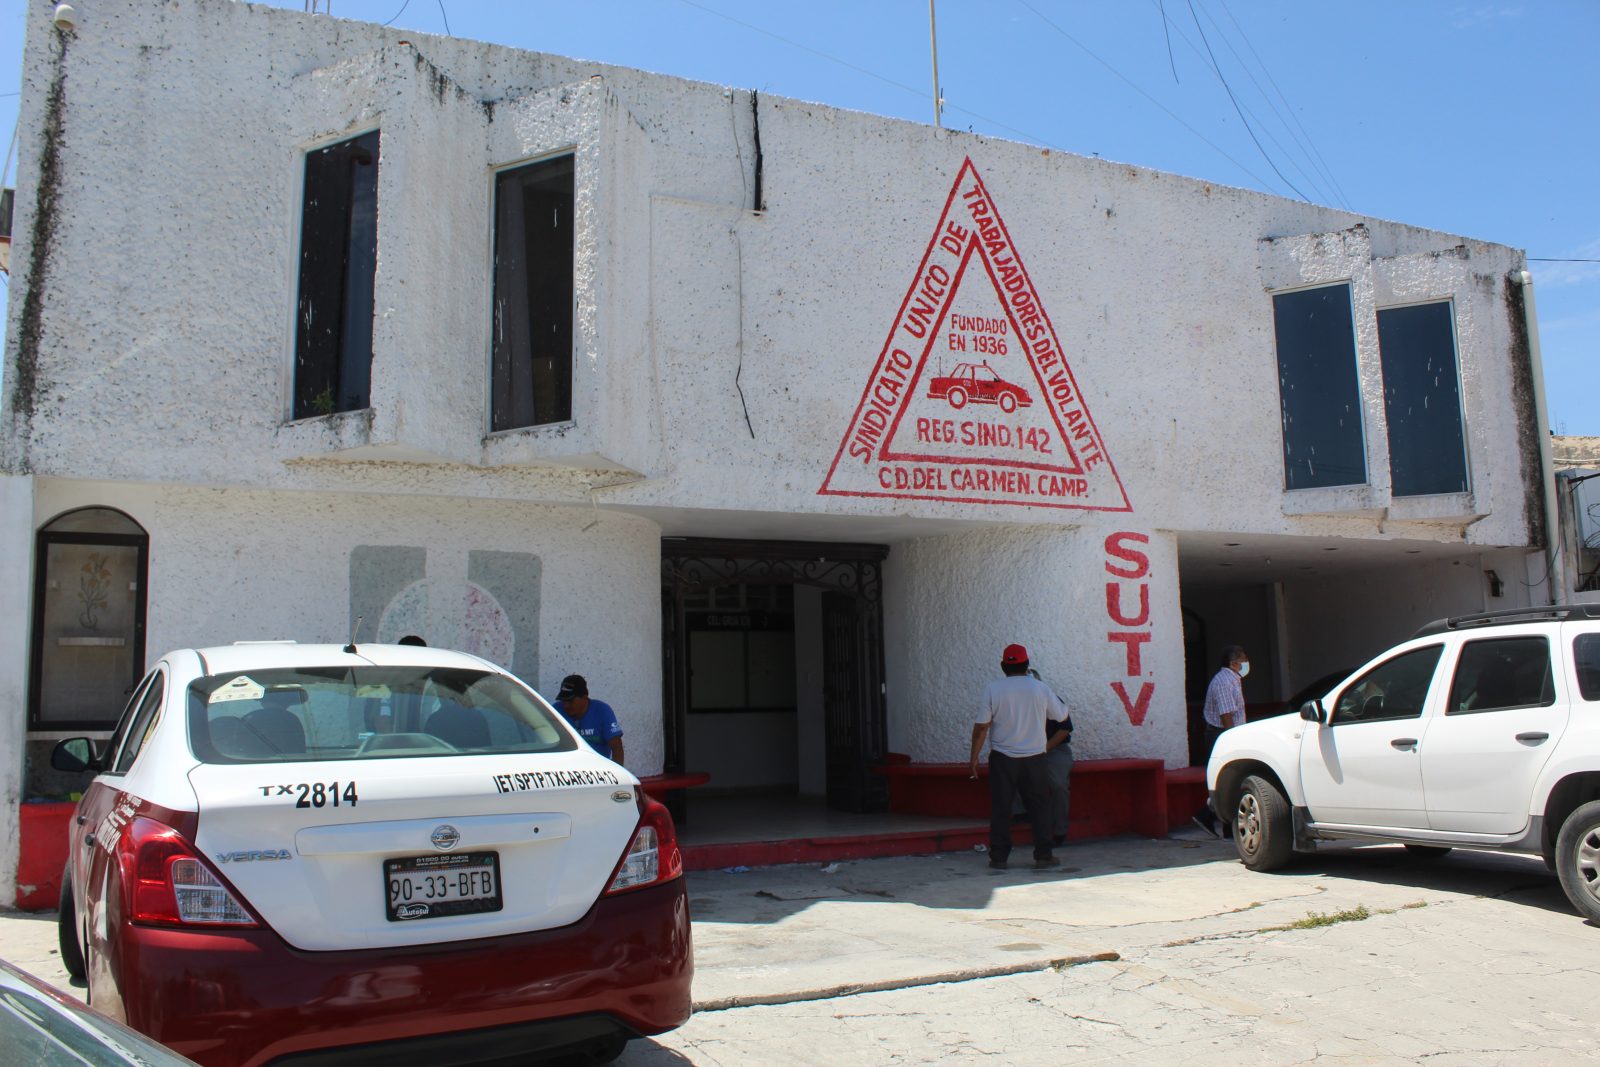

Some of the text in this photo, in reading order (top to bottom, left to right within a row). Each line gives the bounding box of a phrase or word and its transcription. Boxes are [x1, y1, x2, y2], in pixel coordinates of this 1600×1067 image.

[951, 313, 1008, 335] FUNDADO
[963, 184, 1046, 341] TRABAJADORES
[1032, 338, 1058, 374] DEL
[1047, 369, 1104, 472] VOLANTE
[850, 220, 969, 465] SINDICATO UNICO DE
[948, 333, 1008, 356] EN 1936
[216, 849, 293, 863] VERSA
[391, 870, 492, 902] 90-33-BFB
